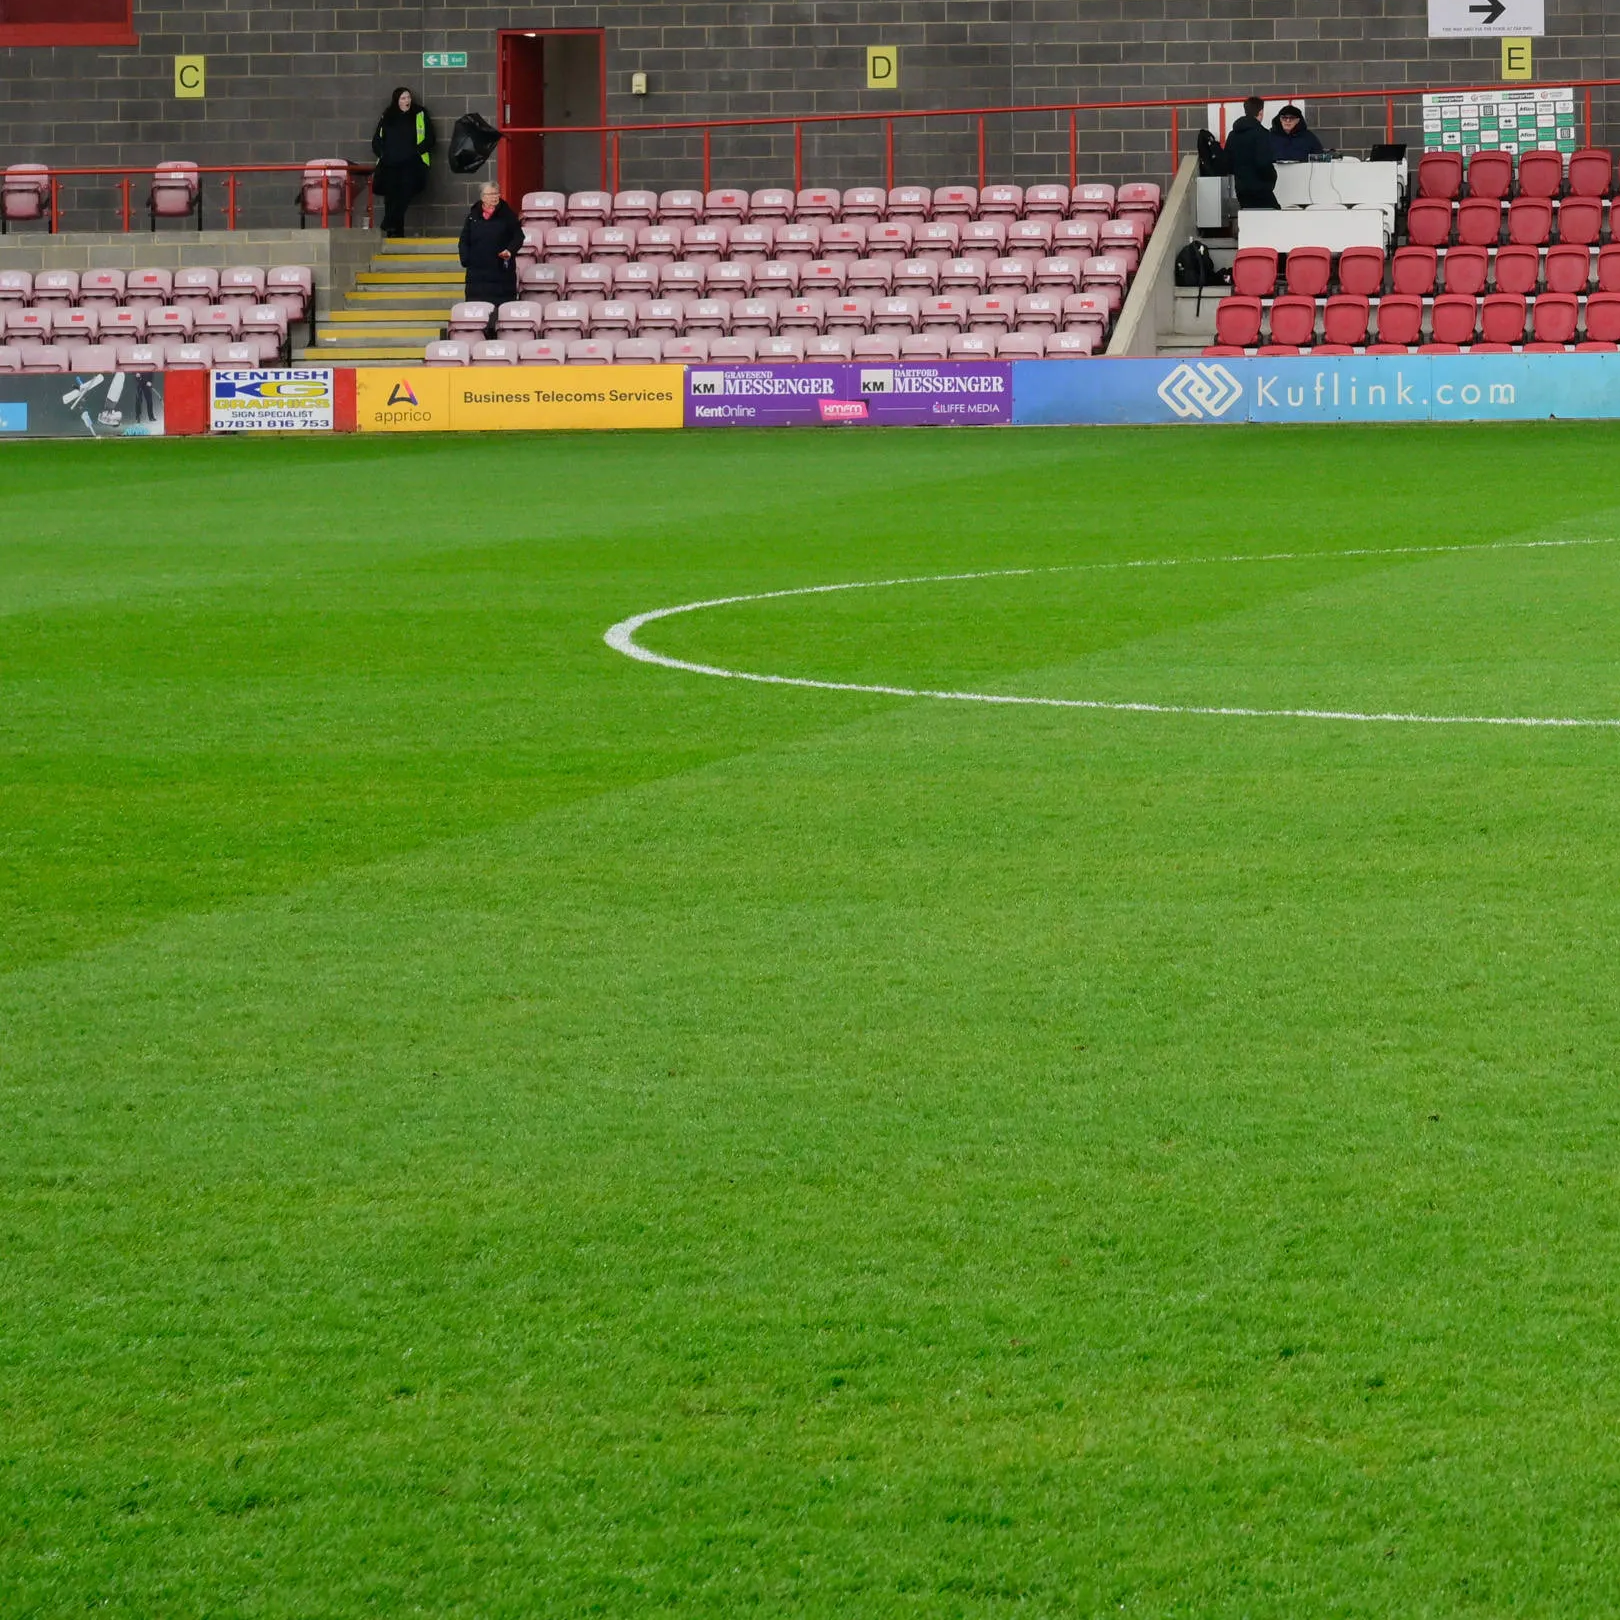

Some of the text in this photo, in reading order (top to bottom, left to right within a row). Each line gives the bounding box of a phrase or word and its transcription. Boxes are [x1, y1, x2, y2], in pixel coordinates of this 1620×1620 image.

[1508, 47, 1525, 70] E
[872, 56, 891, 79] D
[179, 65, 200, 88] C
[215, 370, 329, 381] KENTISH
[724, 370, 773, 379] GRAVESEND
[894, 368, 939, 377] DARTFORD
[215, 381, 329, 398] KG
[692, 378, 835, 395] KM MESSENGER
[862, 376, 1005, 393] KM MESSENGER
[1257, 371, 1515, 407] Kuflink.com
[214, 399, 330, 409] GRAPHICS
[463, 389, 673, 404] Business Telecoms Services
[257, 410, 314, 418] SPECIALIST
[374, 408, 432, 424] apprico
[695, 405, 756, 417] KentOnline
[967, 404, 1000, 413] MEDIA
[214, 419, 330, 428] 07831 816 753
